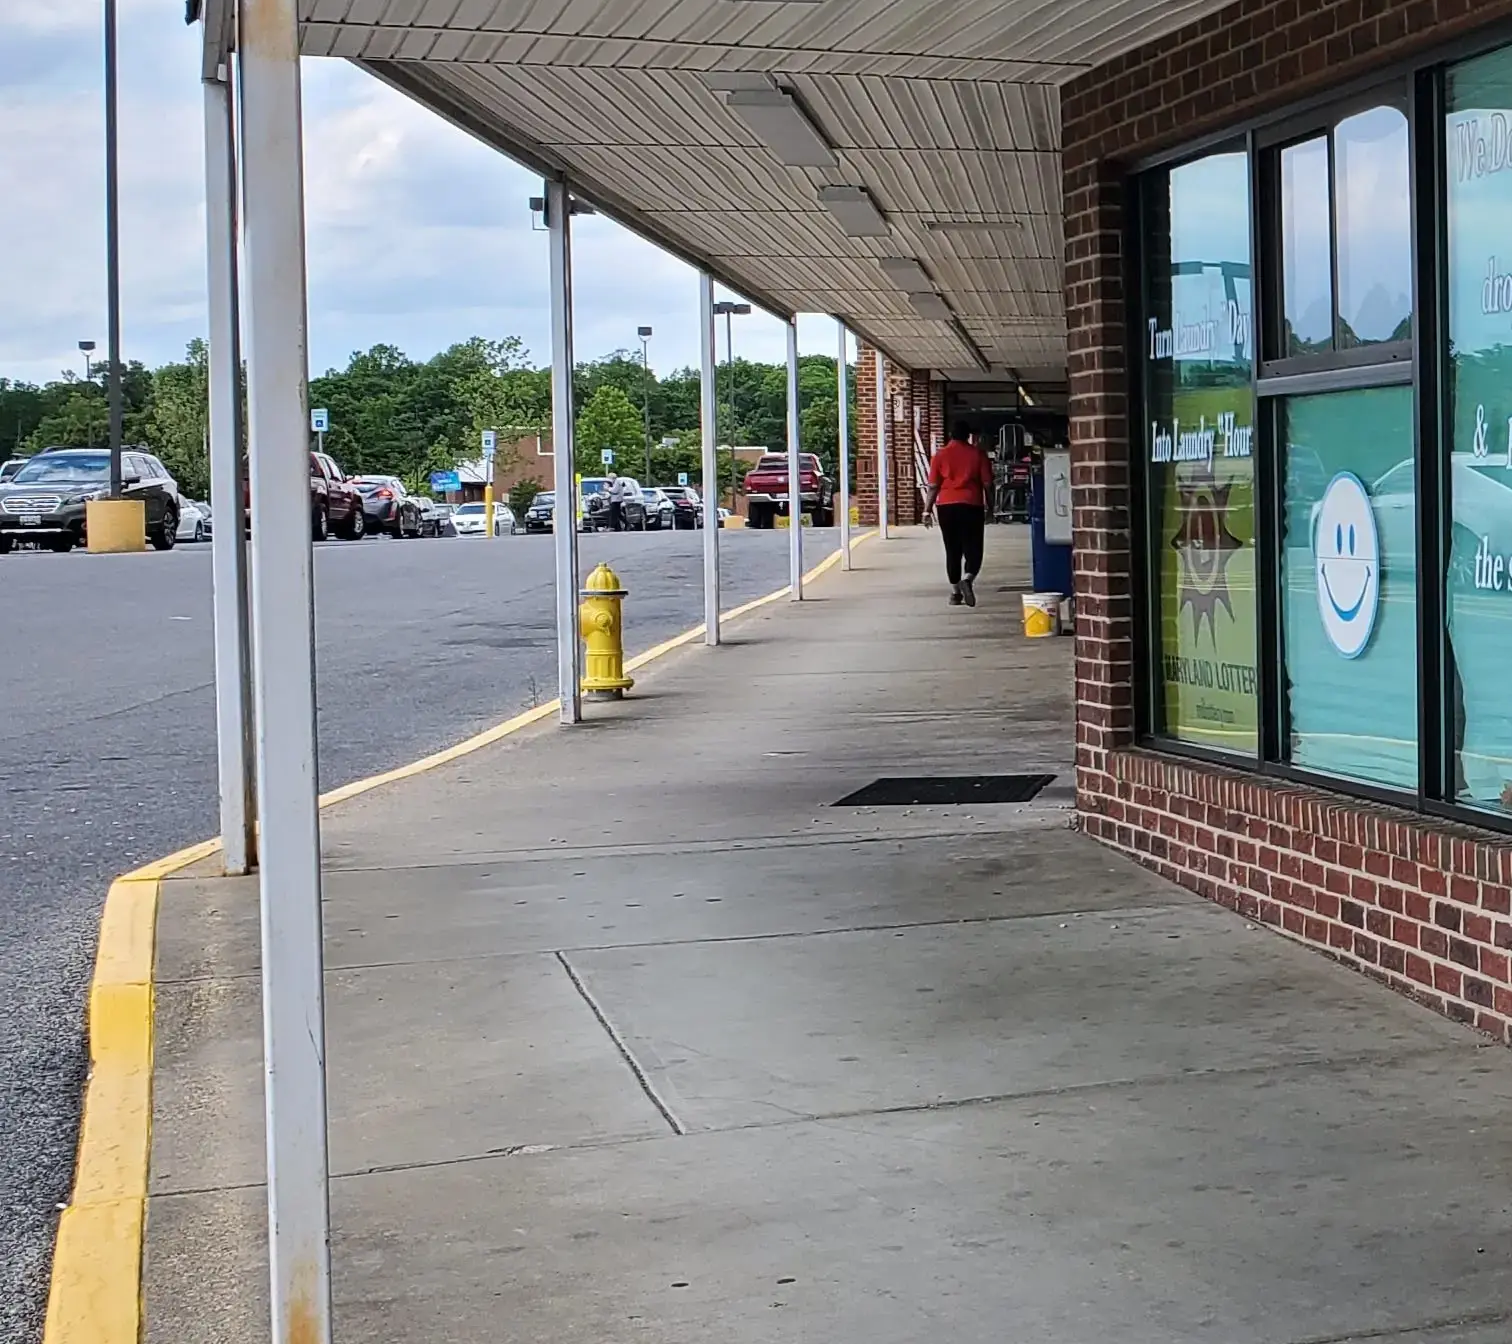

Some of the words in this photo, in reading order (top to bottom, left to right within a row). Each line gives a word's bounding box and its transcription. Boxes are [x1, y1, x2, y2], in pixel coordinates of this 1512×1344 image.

[1456, 118, 1485, 183] We
[1148, 317, 1173, 360] Turn
[1174, 307, 1218, 372] Laundry
[1151, 420, 1172, 462] Into
[1173, 414, 1215, 473] Laundry
[1473, 403, 1488, 457] &
[1475, 535, 1504, 589] the
[1165, 653, 1214, 689] MARYLAND
